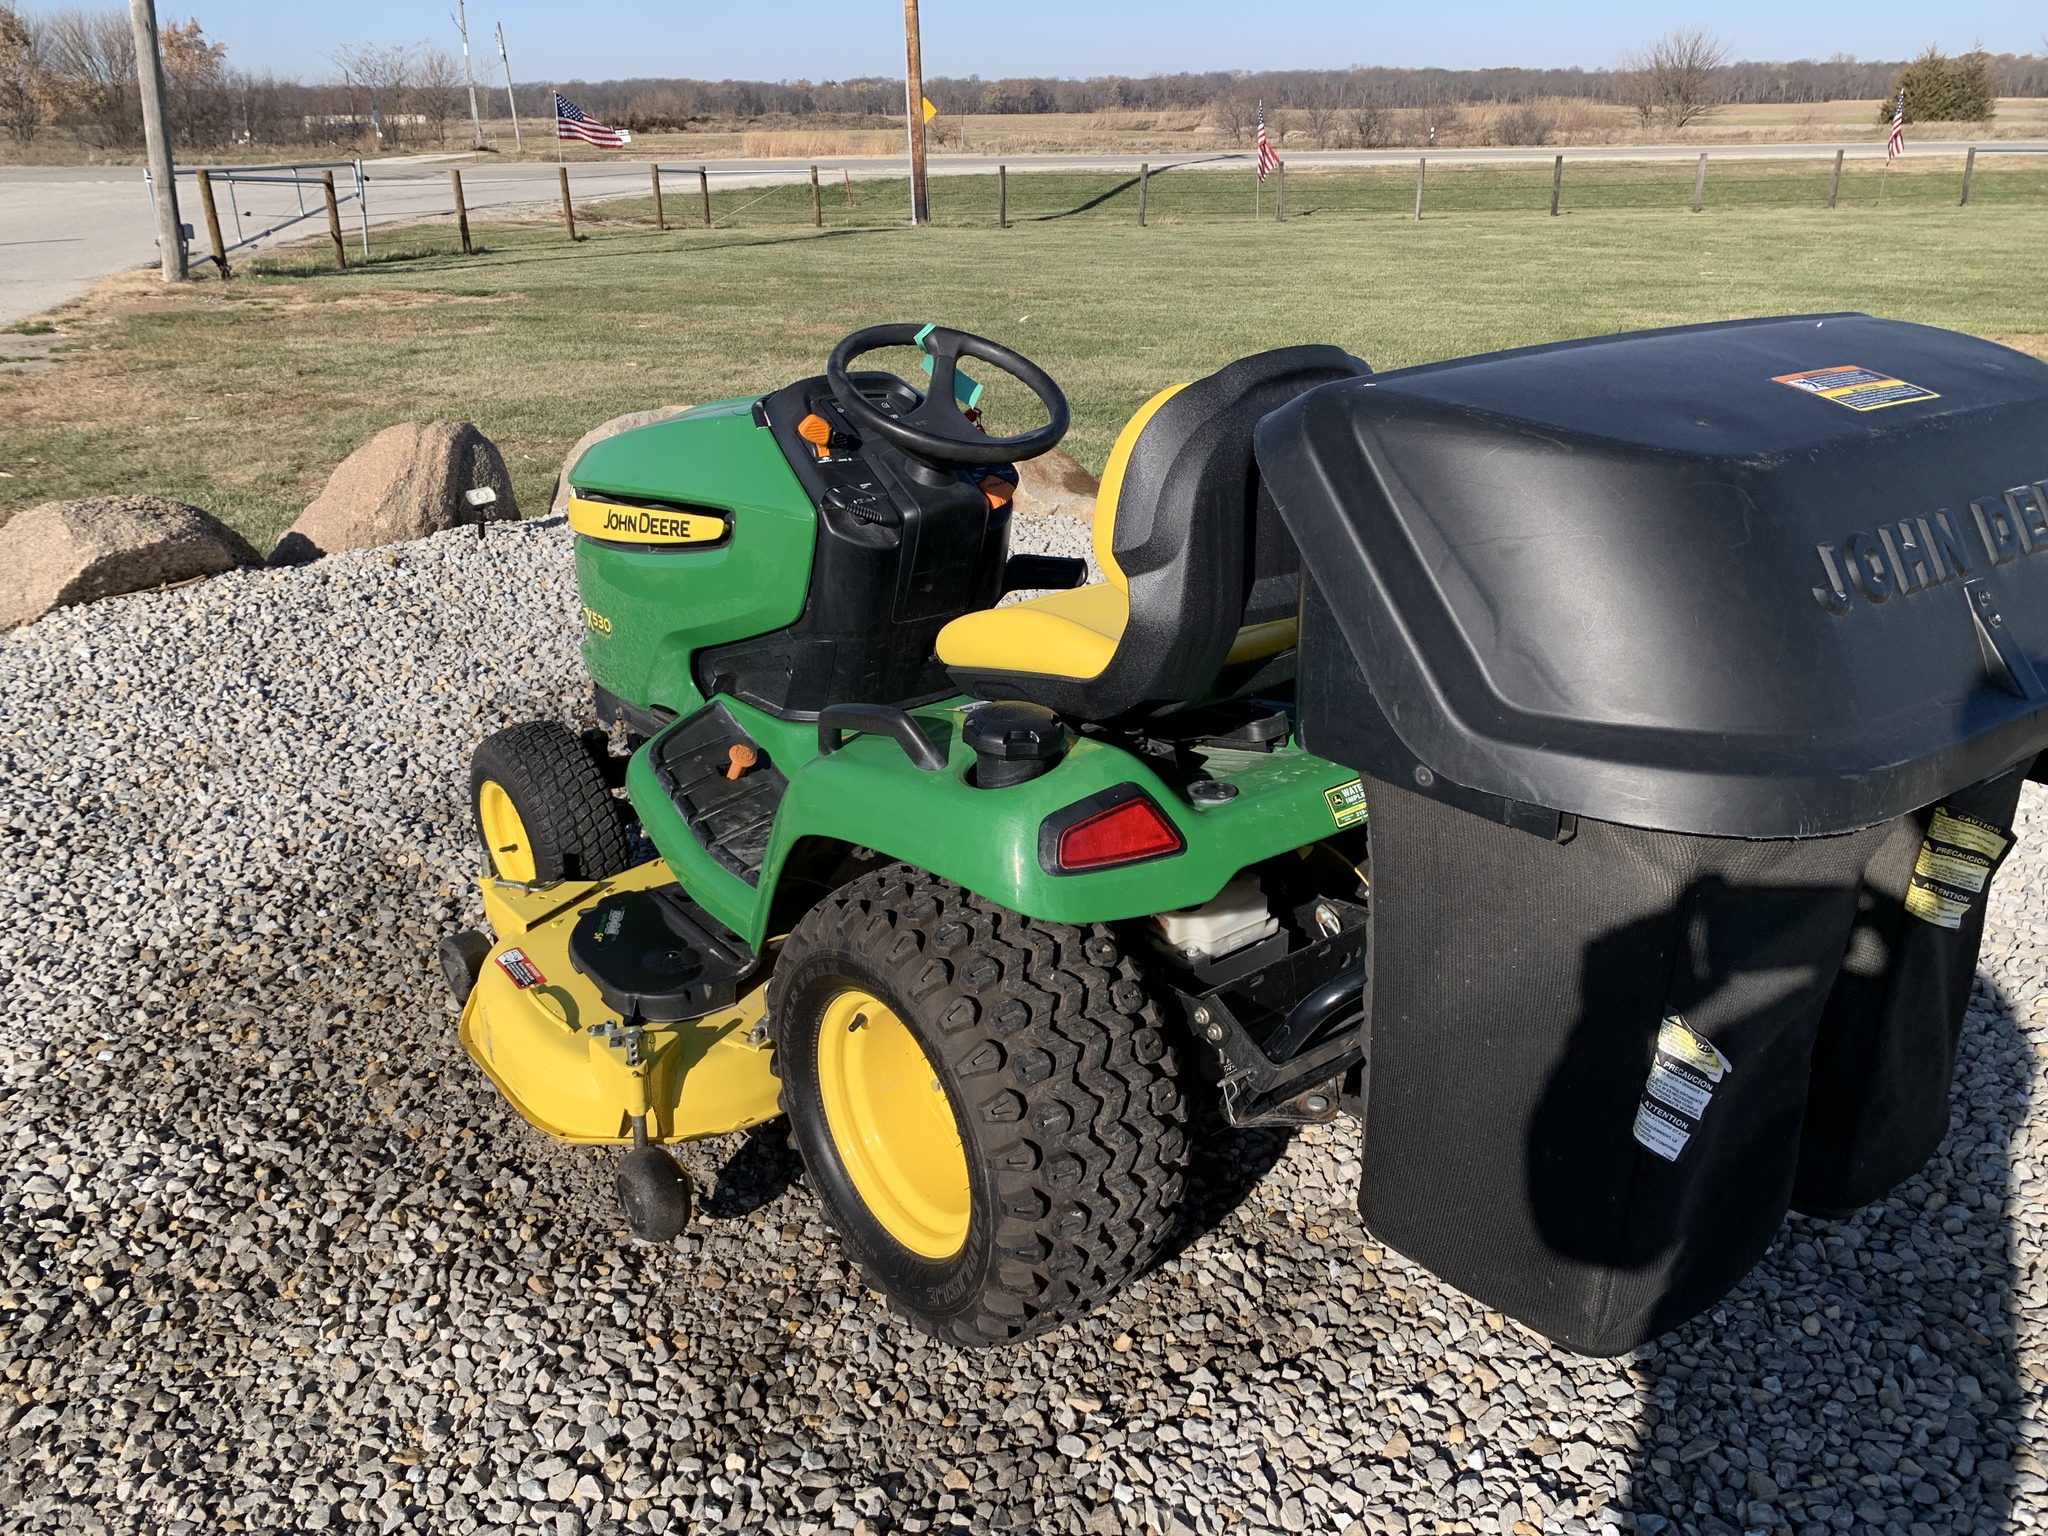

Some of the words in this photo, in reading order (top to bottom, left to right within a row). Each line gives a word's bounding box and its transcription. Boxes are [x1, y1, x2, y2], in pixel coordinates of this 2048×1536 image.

[603, 508, 638, 533] JOHN
[638, 512, 691, 538] DEERE
[1811, 507, 1975, 617] JOHN
[582, 607, 611, 632] X530
[1341, 783, 1364, 797] WATE
[1345, 792, 1366, 804] IMPLE
[1957, 814, 2002, 835] CAUTION
[1935, 846, 1990, 867] PRECAUCION
[1922, 882, 1971, 903] ATTENTION
[1663, 1060, 1714, 1092] PRECAUCION
[1643, 1100, 1690, 1131] ATTENTION
[925, 1197, 983, 1307] CARLISLE
